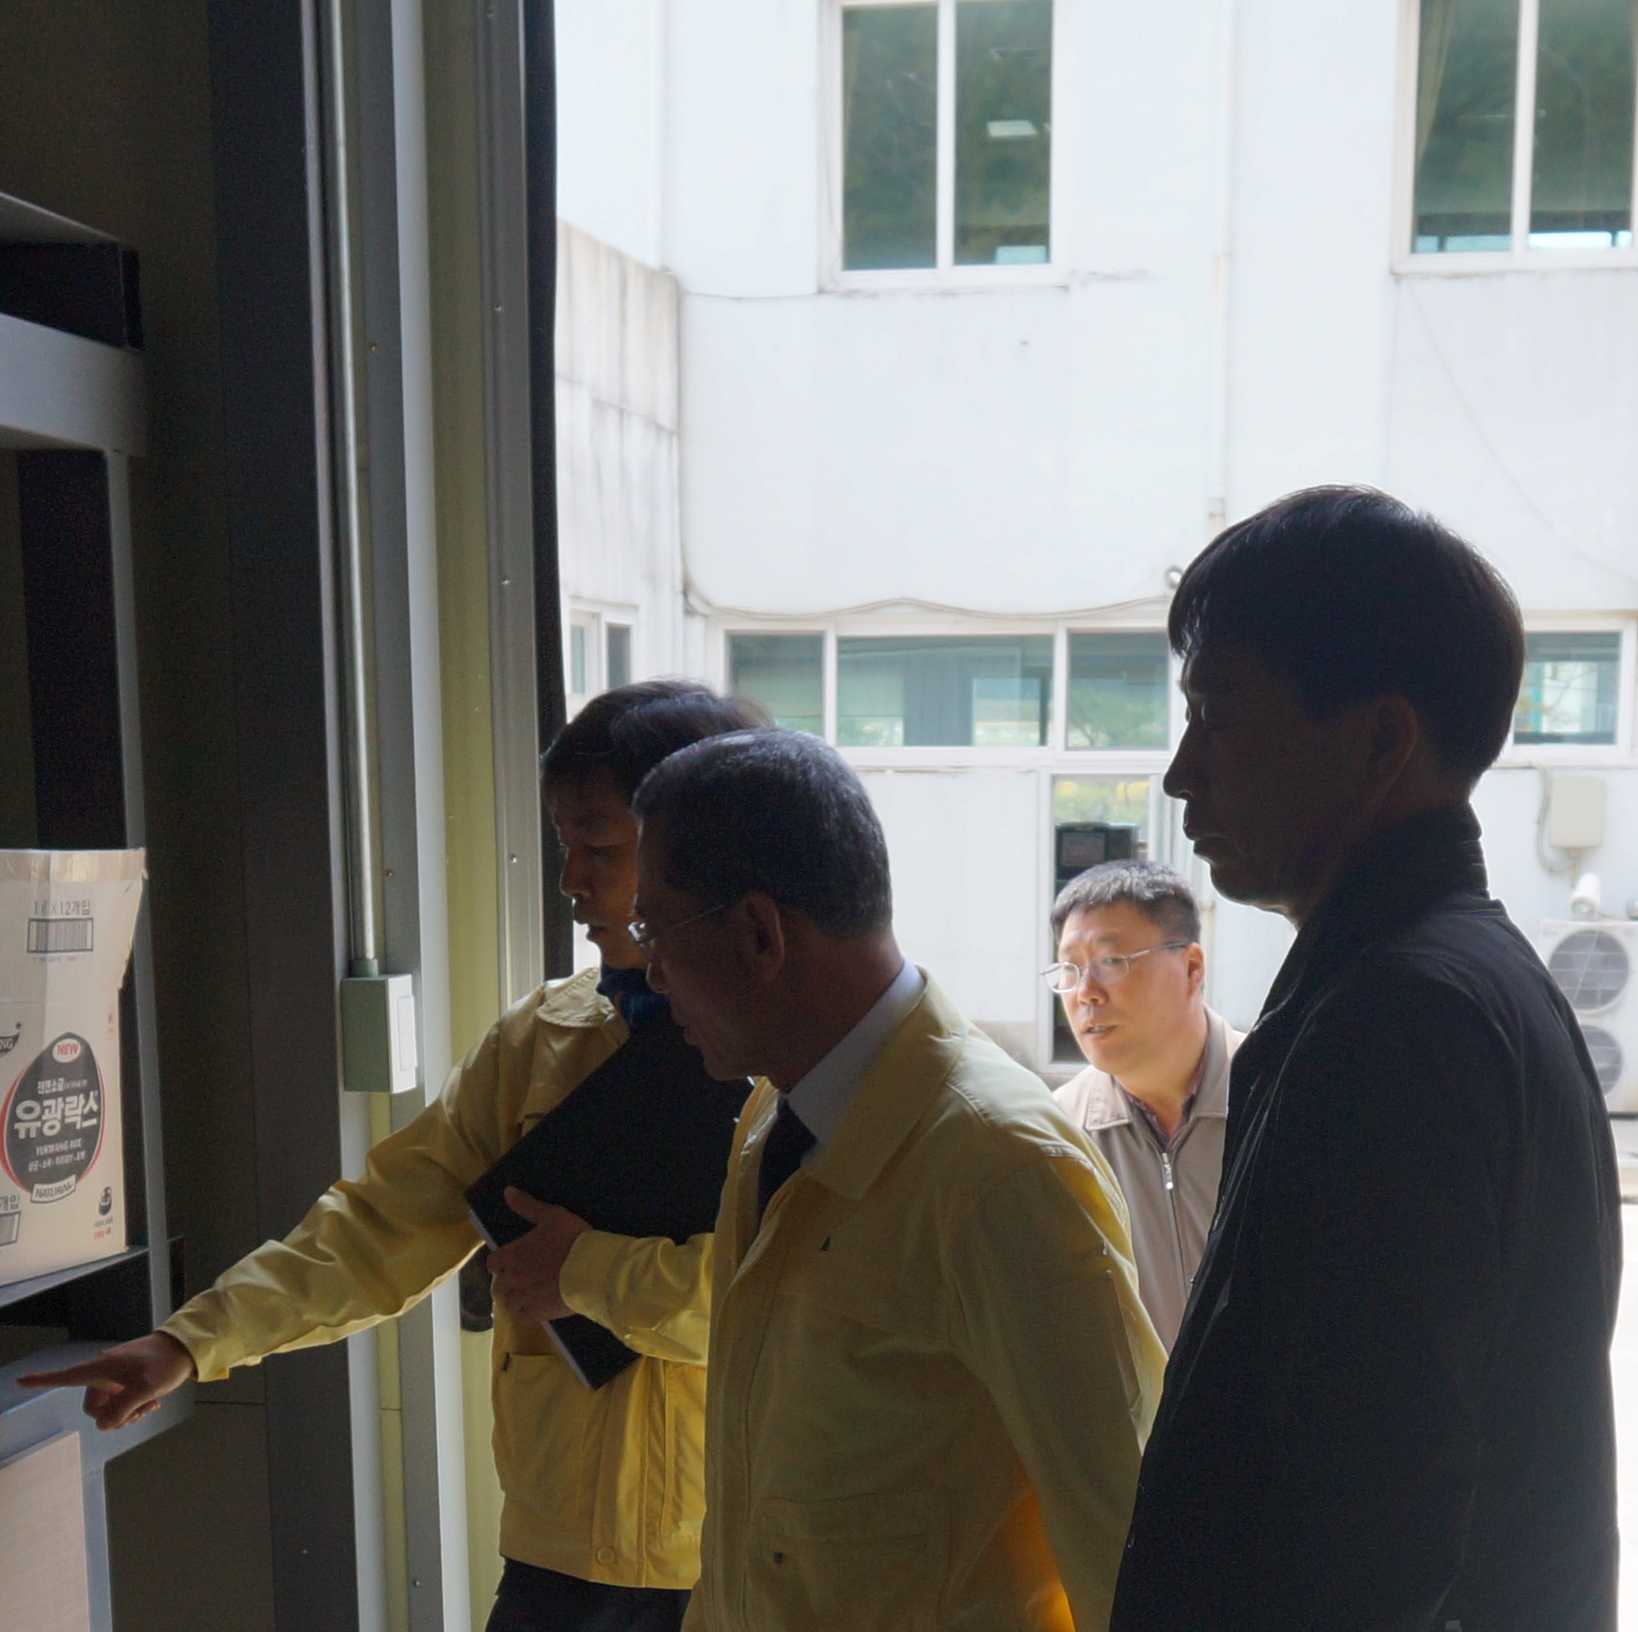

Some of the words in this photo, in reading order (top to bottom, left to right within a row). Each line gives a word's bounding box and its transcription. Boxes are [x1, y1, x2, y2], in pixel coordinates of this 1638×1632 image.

[57, 1043, 78, 1056] NEW
[14, 1089, 99, 1139] 유광락스
[34, 1181, 74, 1199] NATURAL
